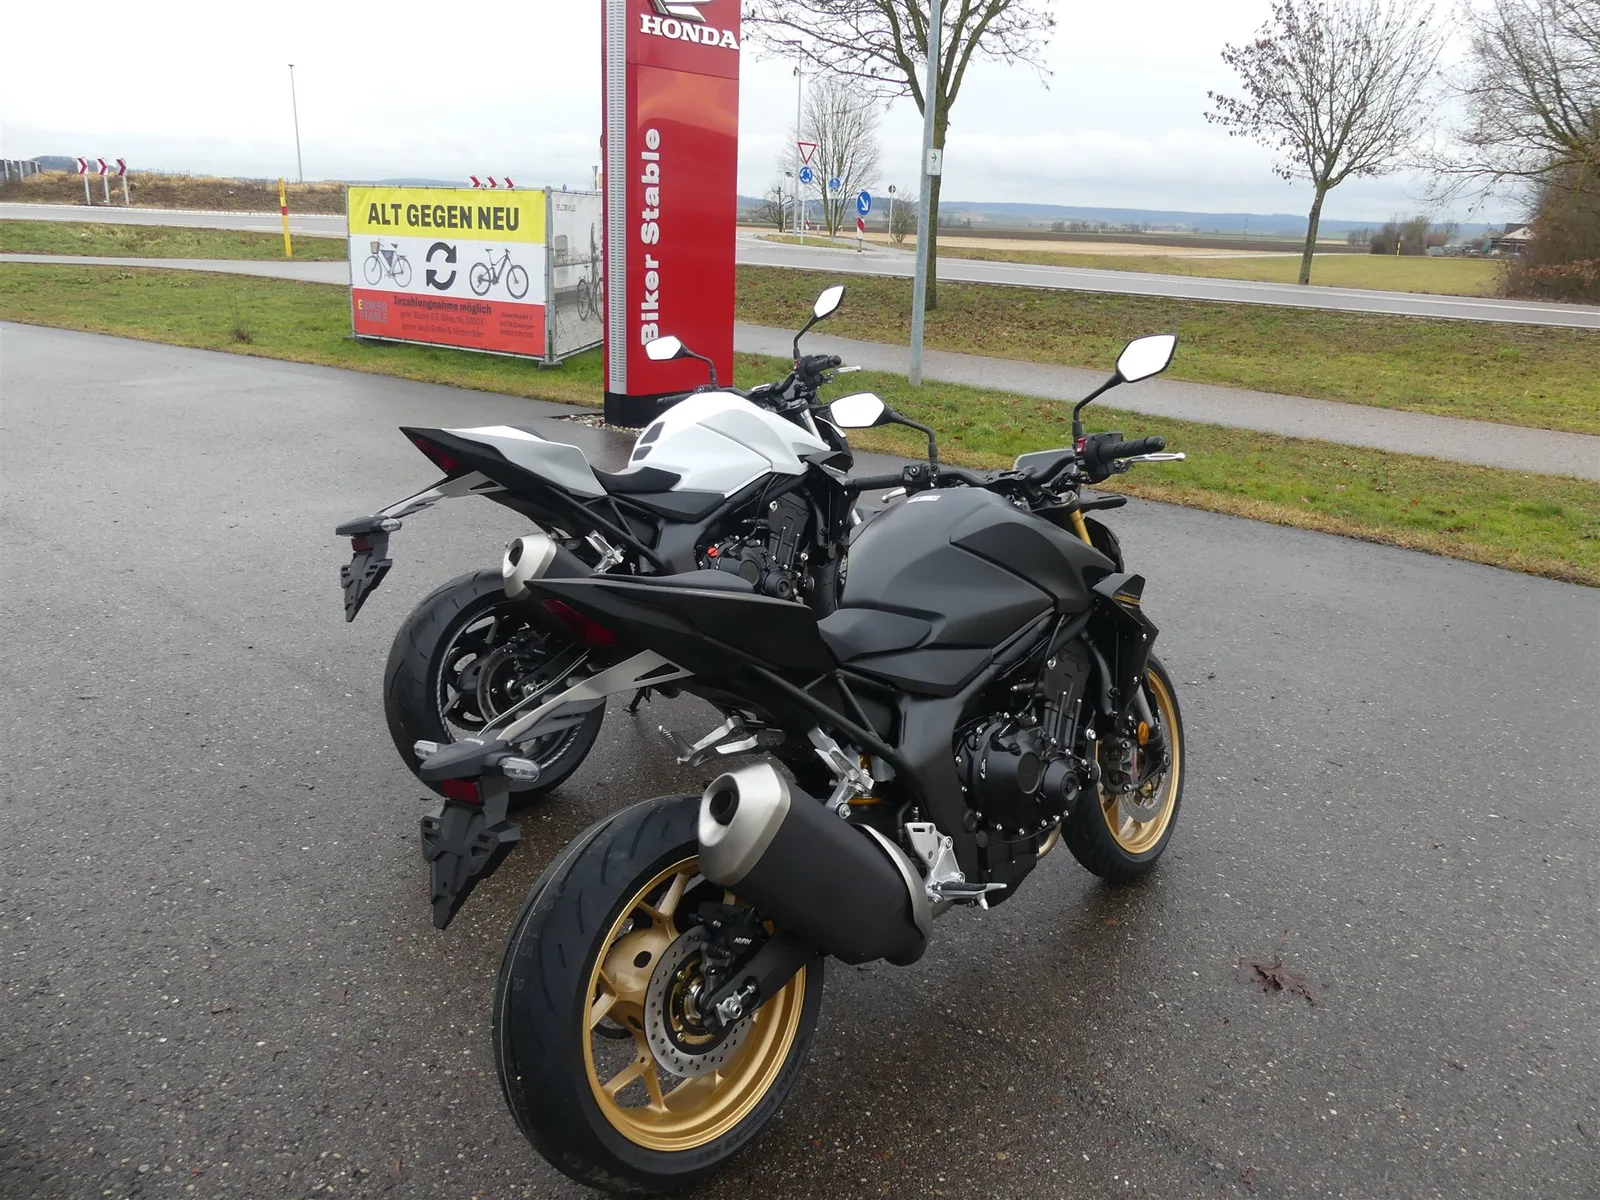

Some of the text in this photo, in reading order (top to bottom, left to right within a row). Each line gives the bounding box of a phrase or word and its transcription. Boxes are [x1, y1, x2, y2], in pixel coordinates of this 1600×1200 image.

[639, 13, 740, 50] HONDA
[367, 202, 520, 232] ALT GEGEN NEU
[641, 128, 660, 347] Biker Stable
[460, 302, 492, 315] möglich
